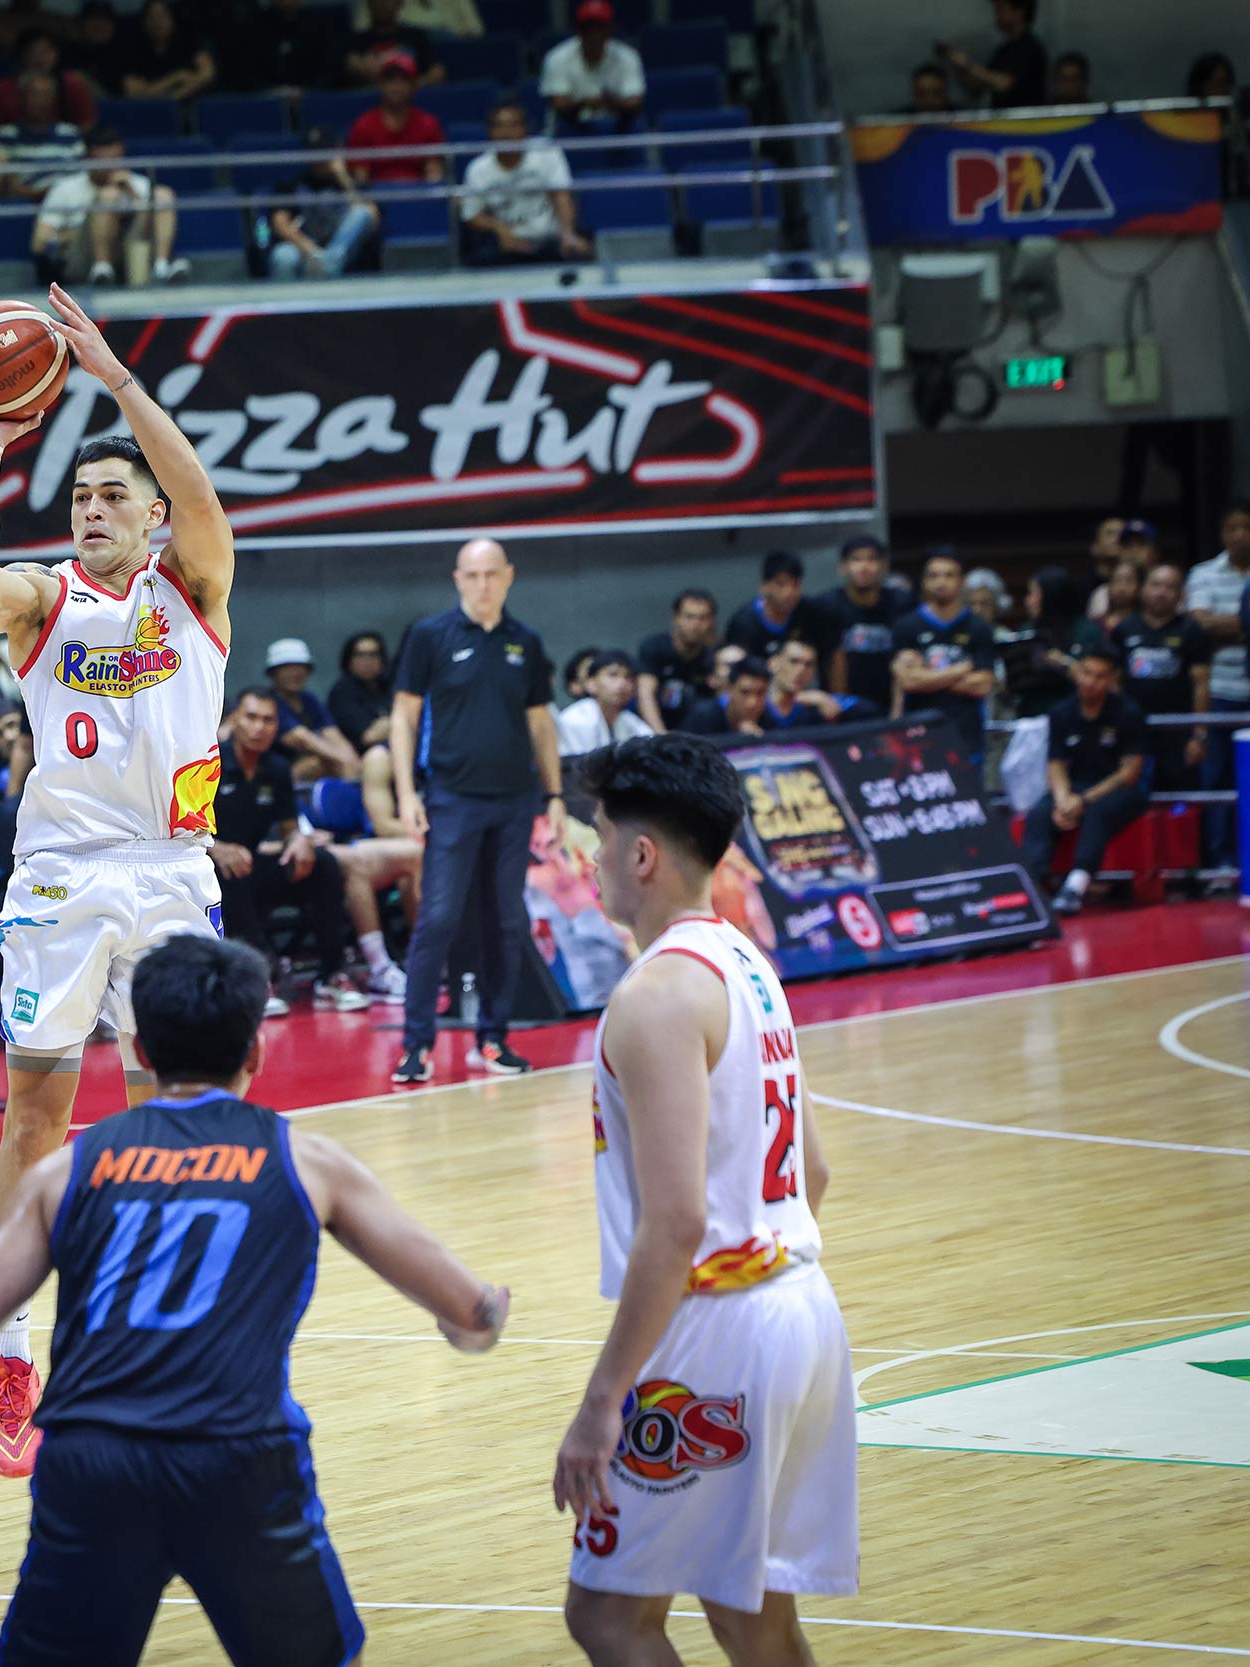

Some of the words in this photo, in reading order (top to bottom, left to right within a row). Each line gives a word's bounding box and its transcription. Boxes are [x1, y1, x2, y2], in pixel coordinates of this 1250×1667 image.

[948, 144, 1116, 225] PBA
[421, 348, 712, 482] Hut
[90, 682, 127, 691] ELASTO
[65, 711, 99, 760] 0
[89, 1144, 268, 1189] MOCON
[86, 1198, 250, 1336] 10
[617, 1387, 751, 1472] OS
